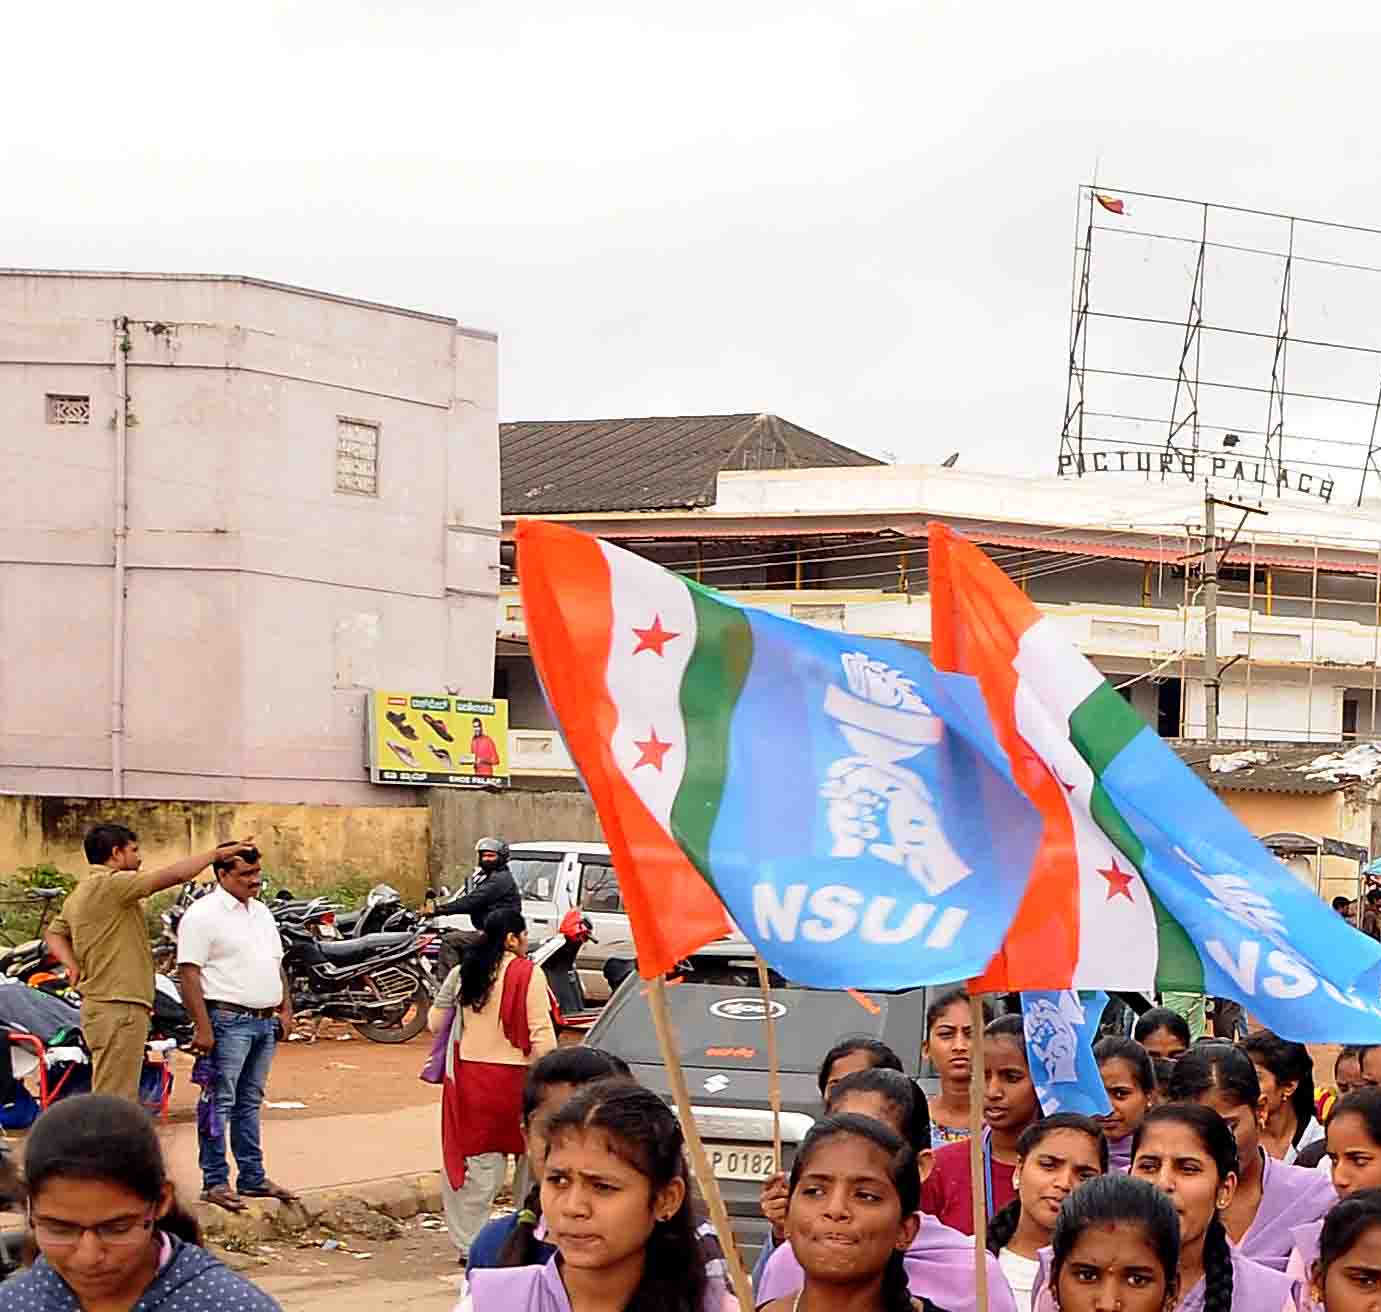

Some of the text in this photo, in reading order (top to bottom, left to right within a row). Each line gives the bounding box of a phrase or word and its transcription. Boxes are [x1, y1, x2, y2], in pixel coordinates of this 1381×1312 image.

[1058, 452, 1335, 501] PICTURE PALACE
[753, 882, 969, 948] NSUI
[728, 1153, 774, 1175] 0182
